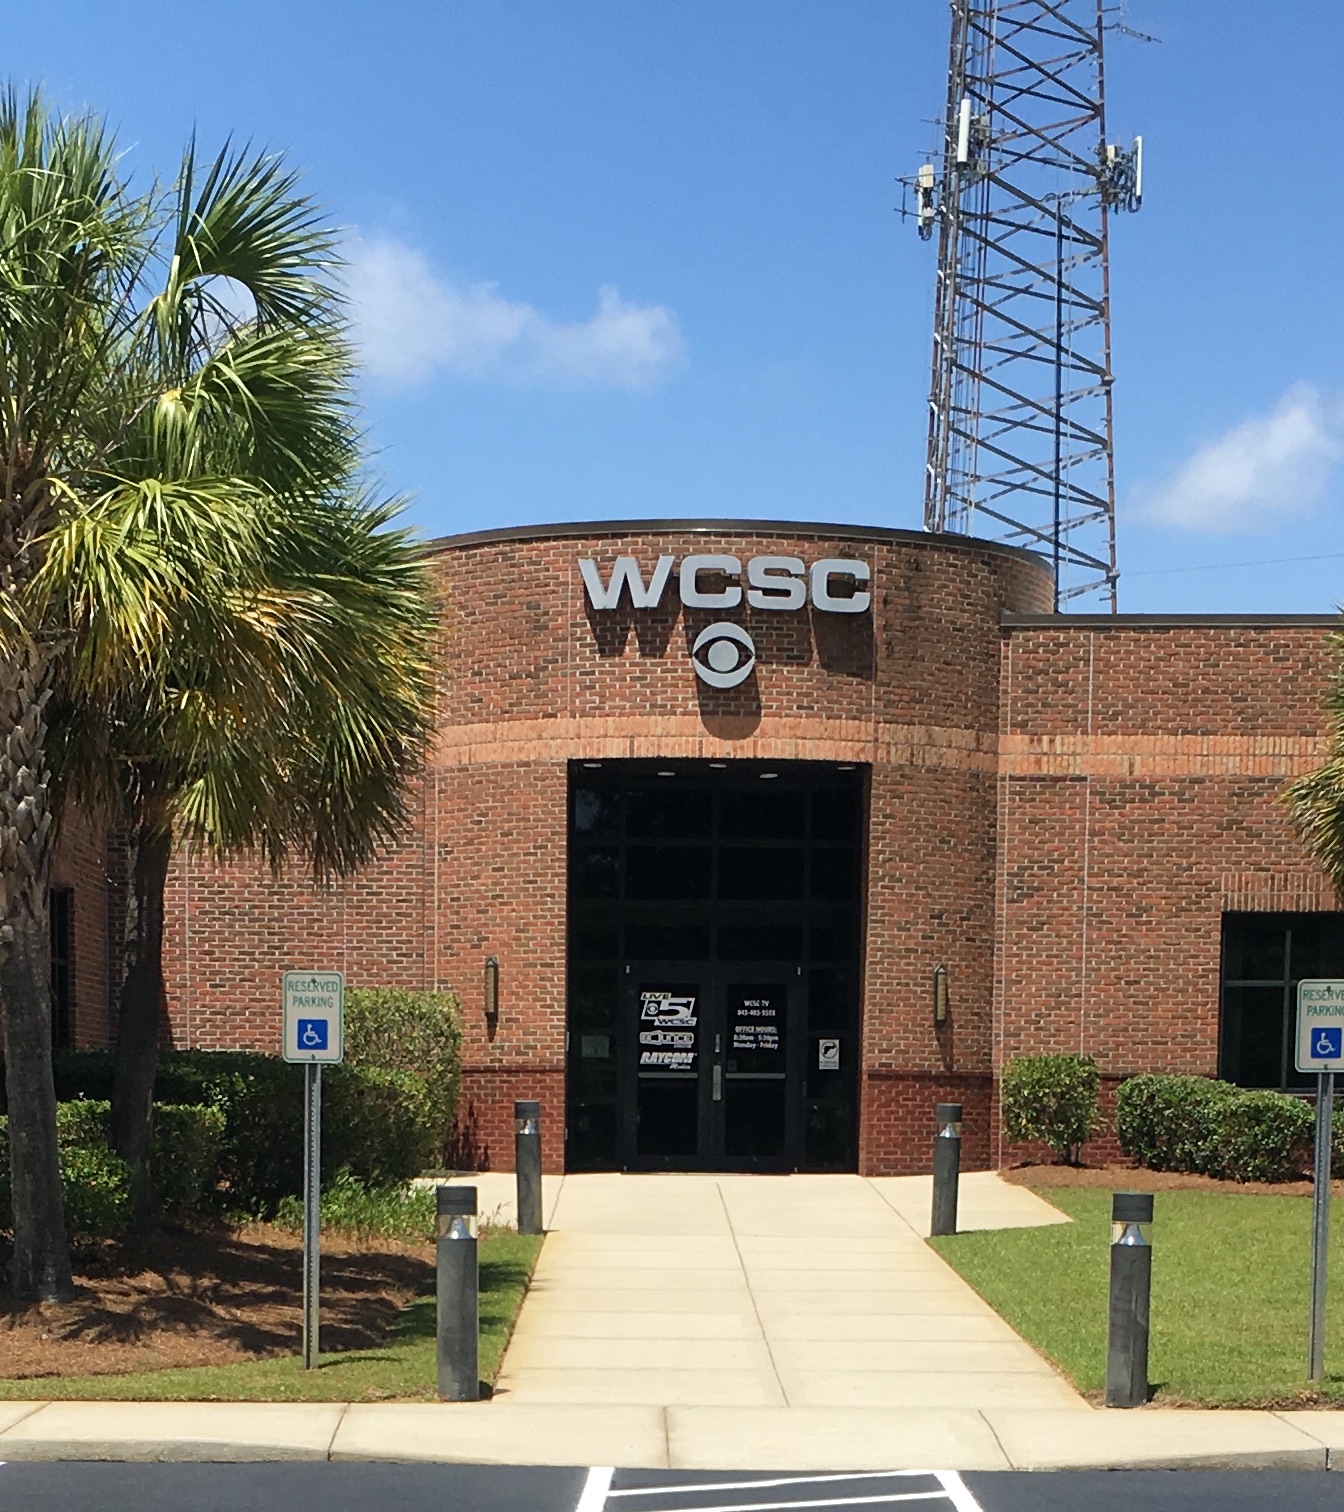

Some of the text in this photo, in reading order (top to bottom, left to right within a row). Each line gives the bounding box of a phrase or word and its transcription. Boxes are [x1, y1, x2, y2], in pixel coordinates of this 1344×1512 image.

[578, 555, 870, 613] WCSC
[287, 980, 339, 992] RESERVED
[292, 996, 334, 1008] PARKING
[641, 992, 671, 1000] LIVE
[657, 999, 690, 1020] 5
[657, 1017, 695, 1025] WCSC
[640, 1052, 694, 1064] RAYCOM
